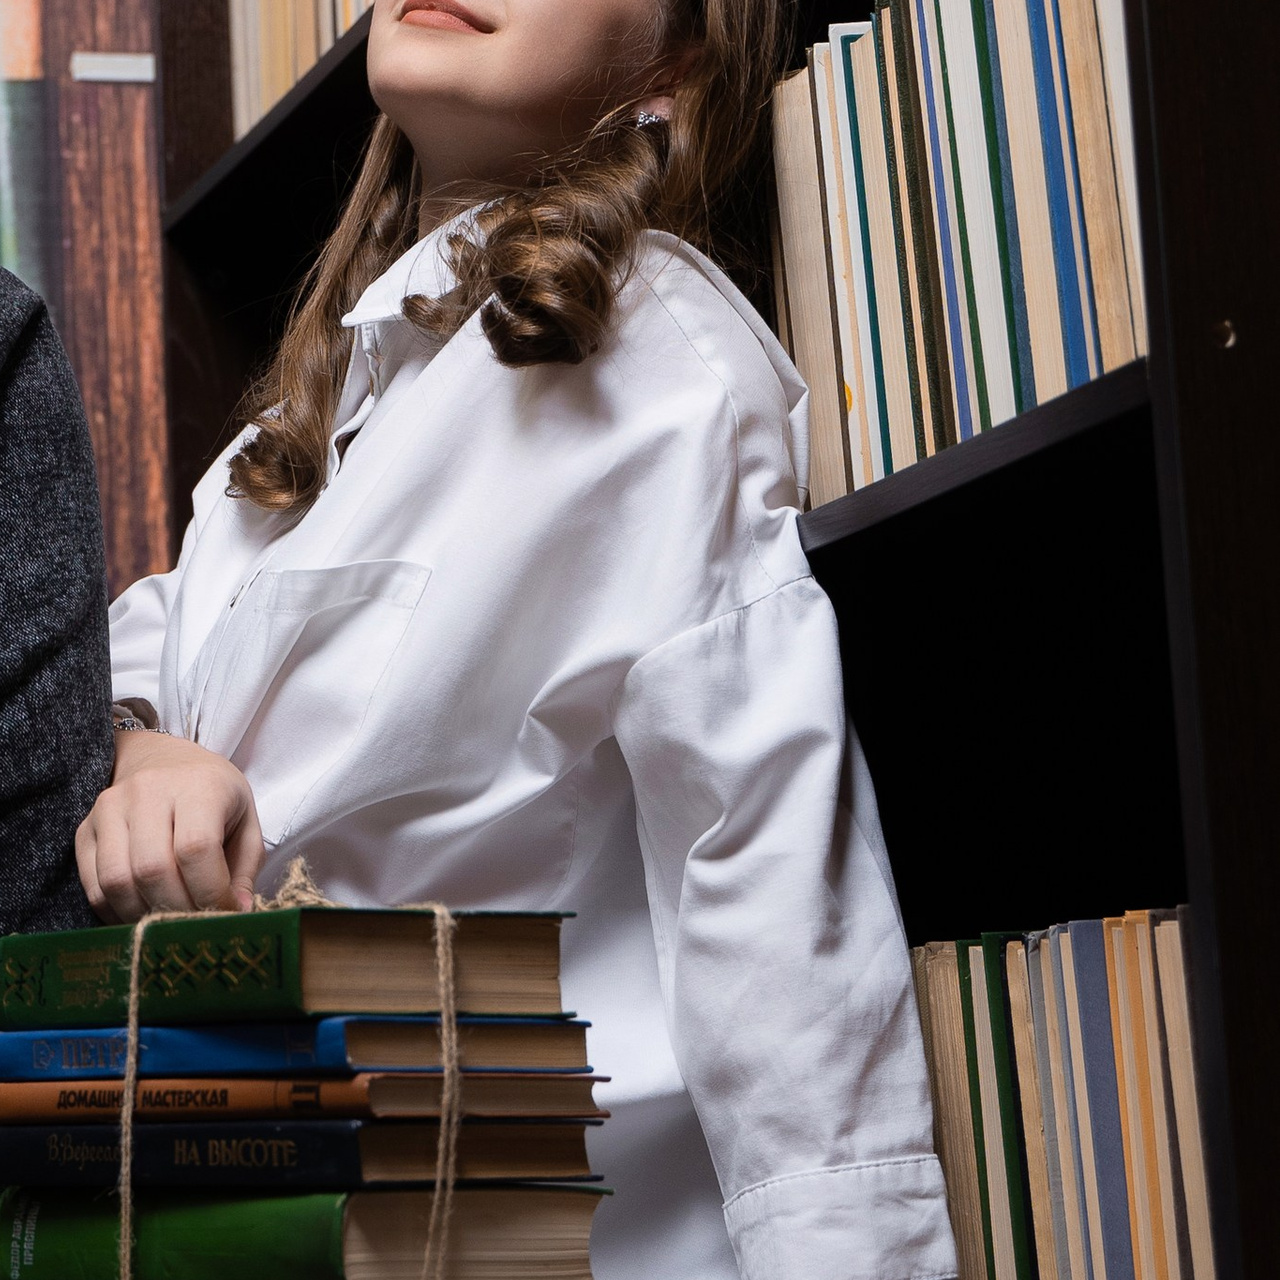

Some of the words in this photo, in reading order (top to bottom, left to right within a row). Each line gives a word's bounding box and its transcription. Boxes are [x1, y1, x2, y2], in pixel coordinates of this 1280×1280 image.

[61, 1037, 125, 1070] ПЕТР
[57, 1089, 136, 1110] ДОМАШН
[141, 1088, 229, 1108] МАСТЕРСКАЯ
[47, 1133, 133, 1170] В.Вересае
[174, 1138, 201, 1166] НА
[208, 1138, 299, 1168] ВЫСОТЕ
[10, 1240, 21, 1280] ФЕДОР
